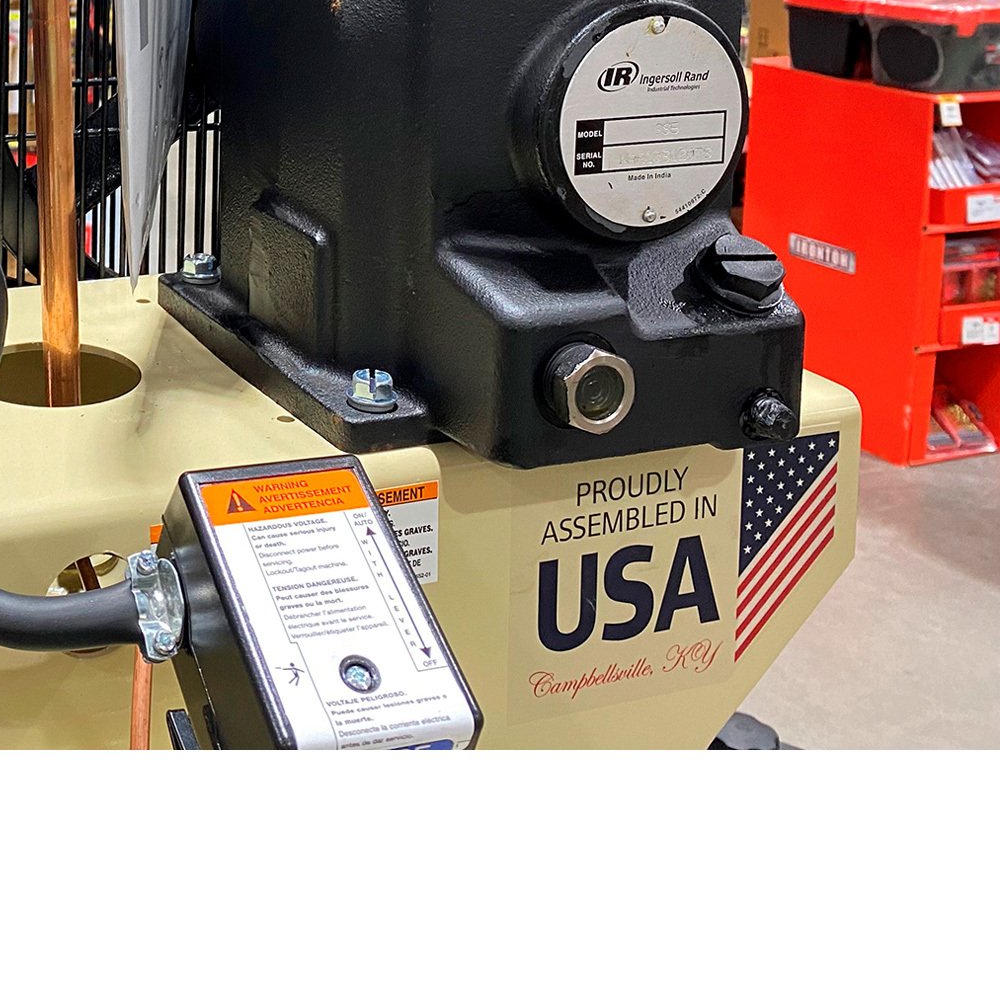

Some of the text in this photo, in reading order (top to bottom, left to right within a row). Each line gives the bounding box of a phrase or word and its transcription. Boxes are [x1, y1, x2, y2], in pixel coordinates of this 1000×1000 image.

[640, 72, 682, 87] Ingersoll
[684, 70, 710, 81] Rand
[670, 84, 700, 92] Technologies
[577, 130, 603, 138] MODEL
[576, 152, 602, 160] SERIAL
[582, 161, 595, 169] NO.
[628, 173, 645, 181] Made
[794, 237, 849, 269] IRONTON
[253, 480, 308, 493] WARNING
[577, 467, 689, 506] PROUDLY
[259, 485, 351, 504] AVERTISSEMENT
[379, 486, 425, 504] SEMENT
[263, 497, 344, 514] ADVERTENCIA
[541, 494, 718, 545] ASSEMBLED IN
[248, 522, 292, 532] HAZARDOUS
[404, 525, 433, 536] GRAVES.
[413, 559, 421, 567] DE
[272, 582, 305, 592] TENSION
[538, 535, 720, 652] USA
[423, 659, 437, 667] OFF
[529, 638, 724, 699] Campbellsville, KY
[326, 698, 359, 707] VOLTAJE
